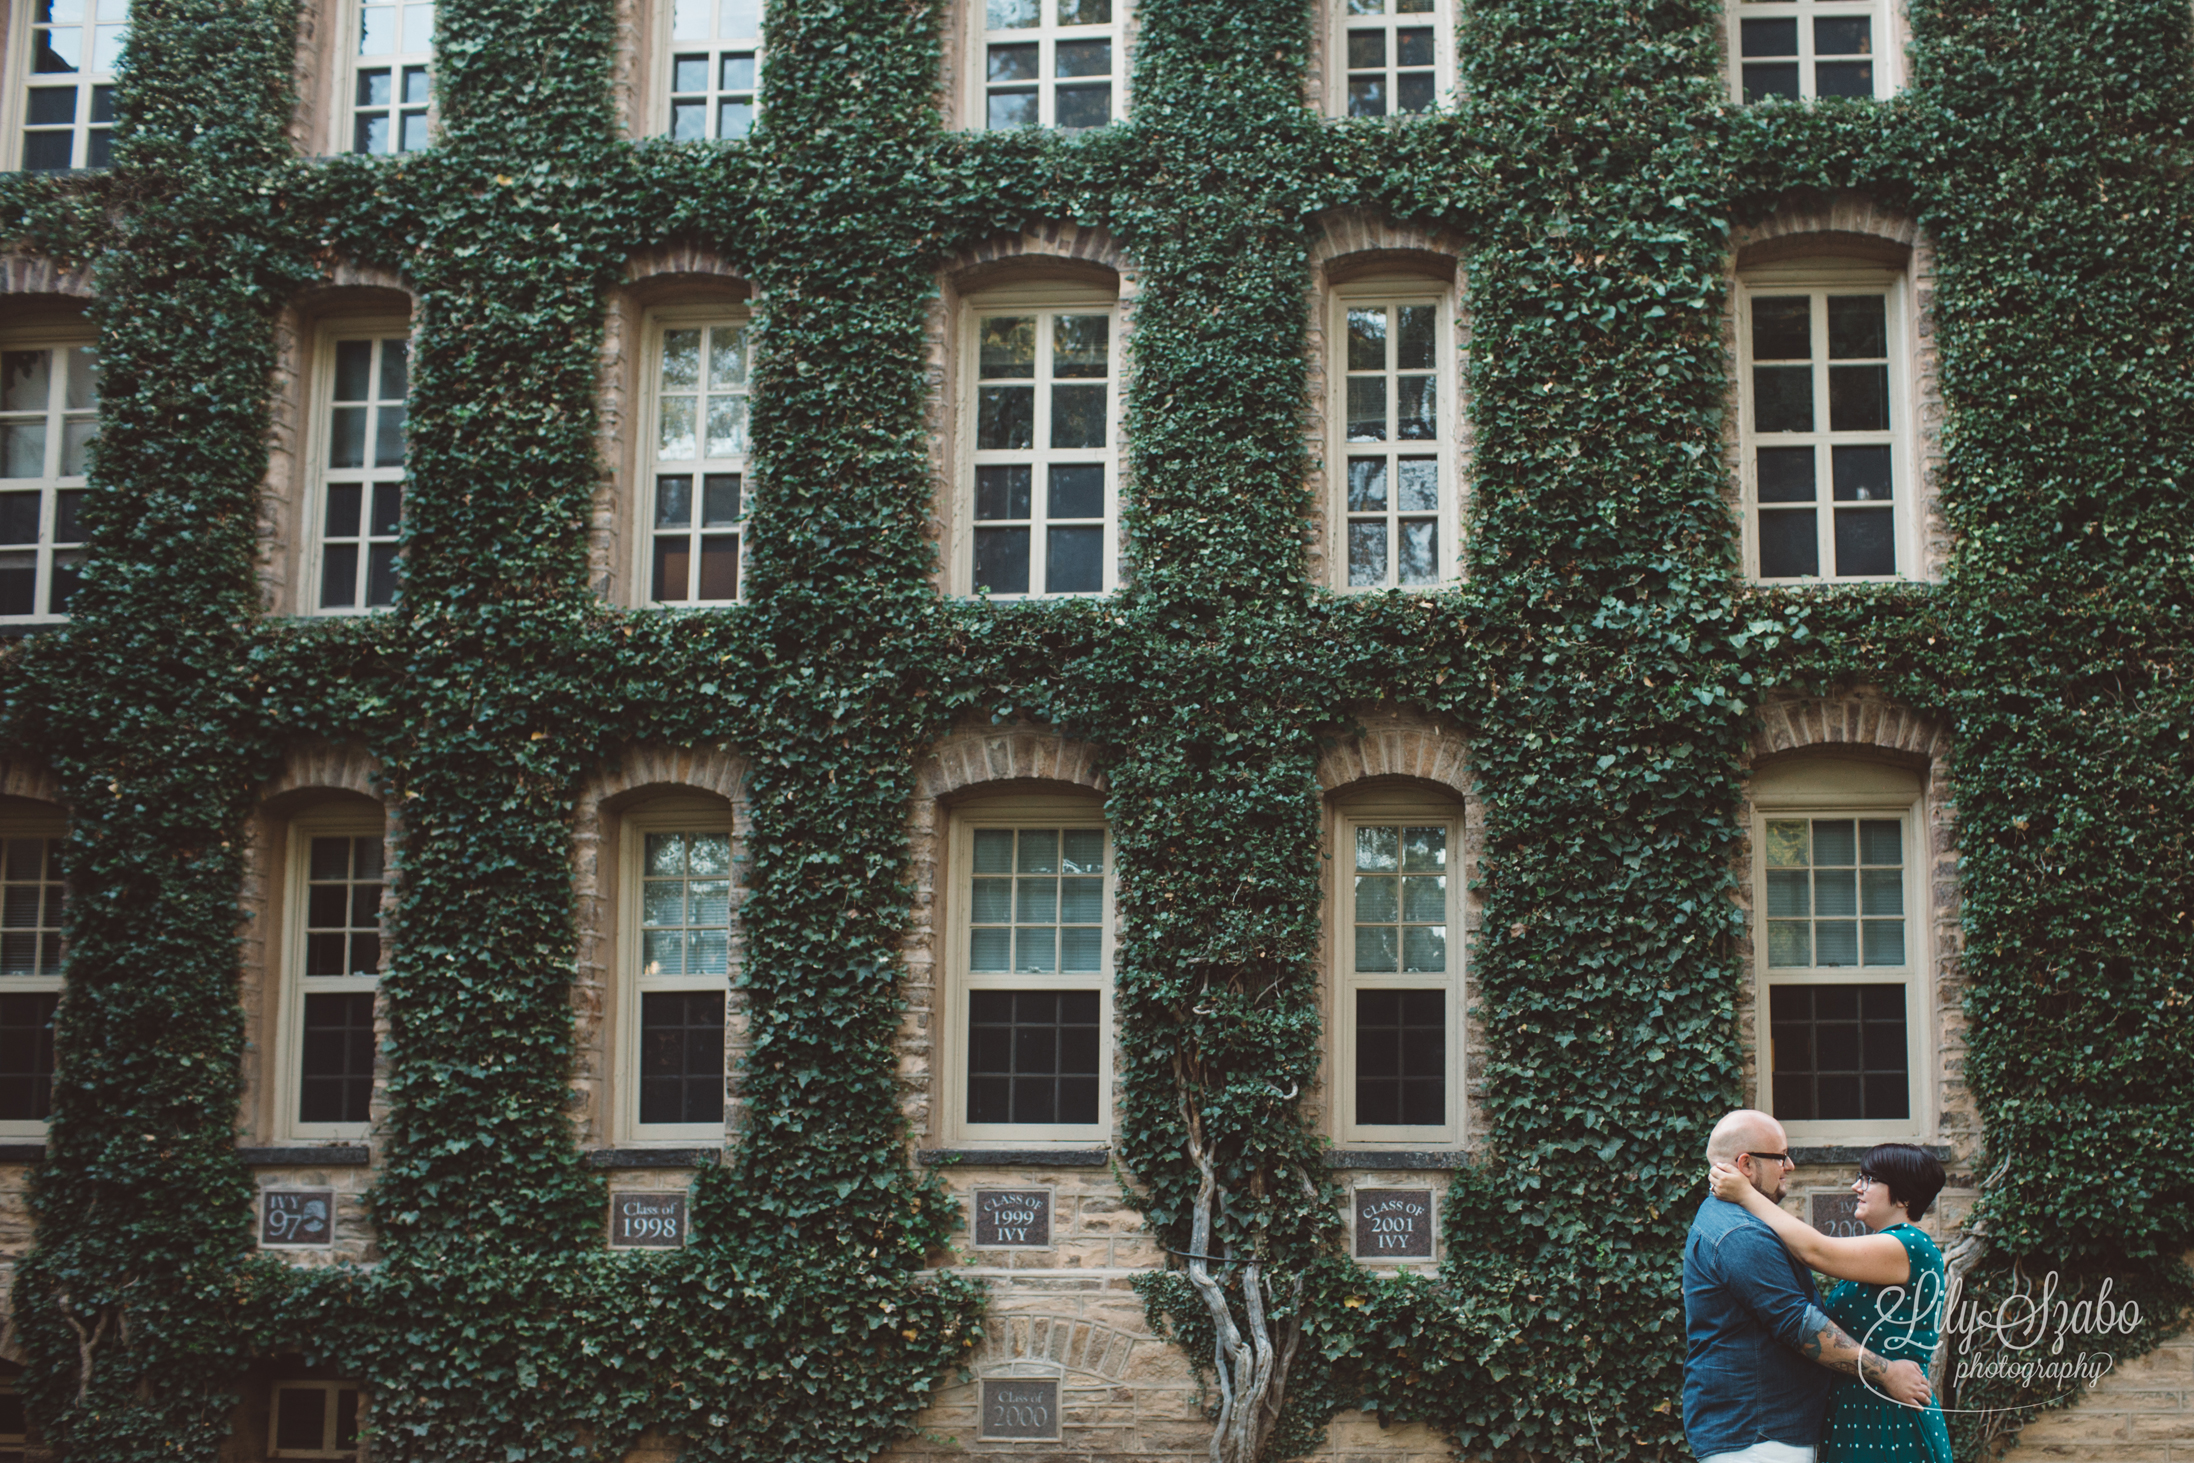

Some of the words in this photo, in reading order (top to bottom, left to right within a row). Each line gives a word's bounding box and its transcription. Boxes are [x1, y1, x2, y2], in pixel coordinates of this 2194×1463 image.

[270, 1195, 301, 1209] IVY
[623, 1202, 658, 1216] Class
[661, 1202, 678, 1215] of
[984, 1194, 1024, 1211] CLASS
[1025, 1197, 1043, 1210] OF
[1363, 1200, 1404, 1219] CLASS
[1405, 1203, 1425, 1217] OF
[1840, 1201, 1858, 1213] IV
[269, 1209, 302, 1240] 97
[994, 1210, 1035, 1225] 1999
[1371, 1217, 1414, 1232] 2001
[623, 1217, 677, 1238] 1998
[997, 1227, 1028, 1241] IVY
[1824, 1220, 1875, 1237] 200
[1378, 1234, 1409, 1248] IVY
[998, 1391, 1028, 1403] Class
[1030, 1391, 1044, 1403] of
[994, 1405, 1048, 1427] 2000
